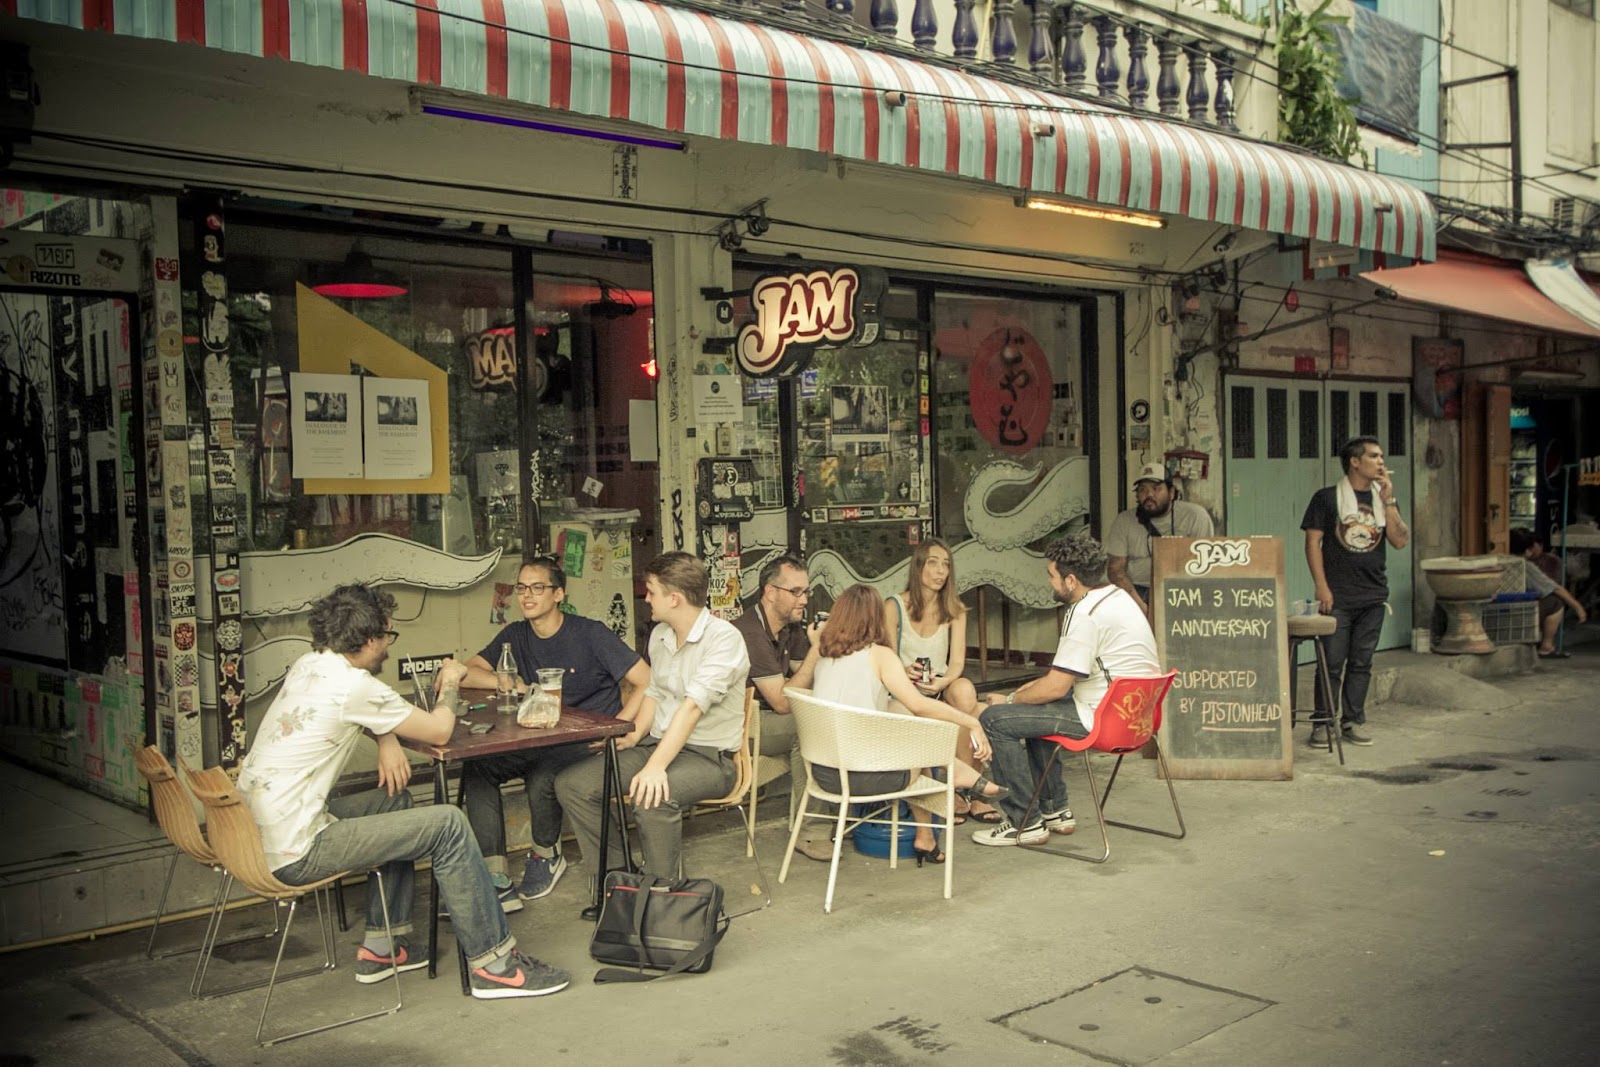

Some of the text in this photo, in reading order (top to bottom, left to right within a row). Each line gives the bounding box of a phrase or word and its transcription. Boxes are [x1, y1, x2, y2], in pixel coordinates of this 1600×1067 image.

[738, 268, 858, 377] JAM
[1186, 540, 1251, 576] JAM
[1168, 587, 1274, 609] JAM 3 YEARS
[1171, 619, 1272, 640] ANNIVERSARY
[1171, 670, 1257, 690] SUPPORTED
[1180, 697, 1282, 724] BY PISTONHEAD
